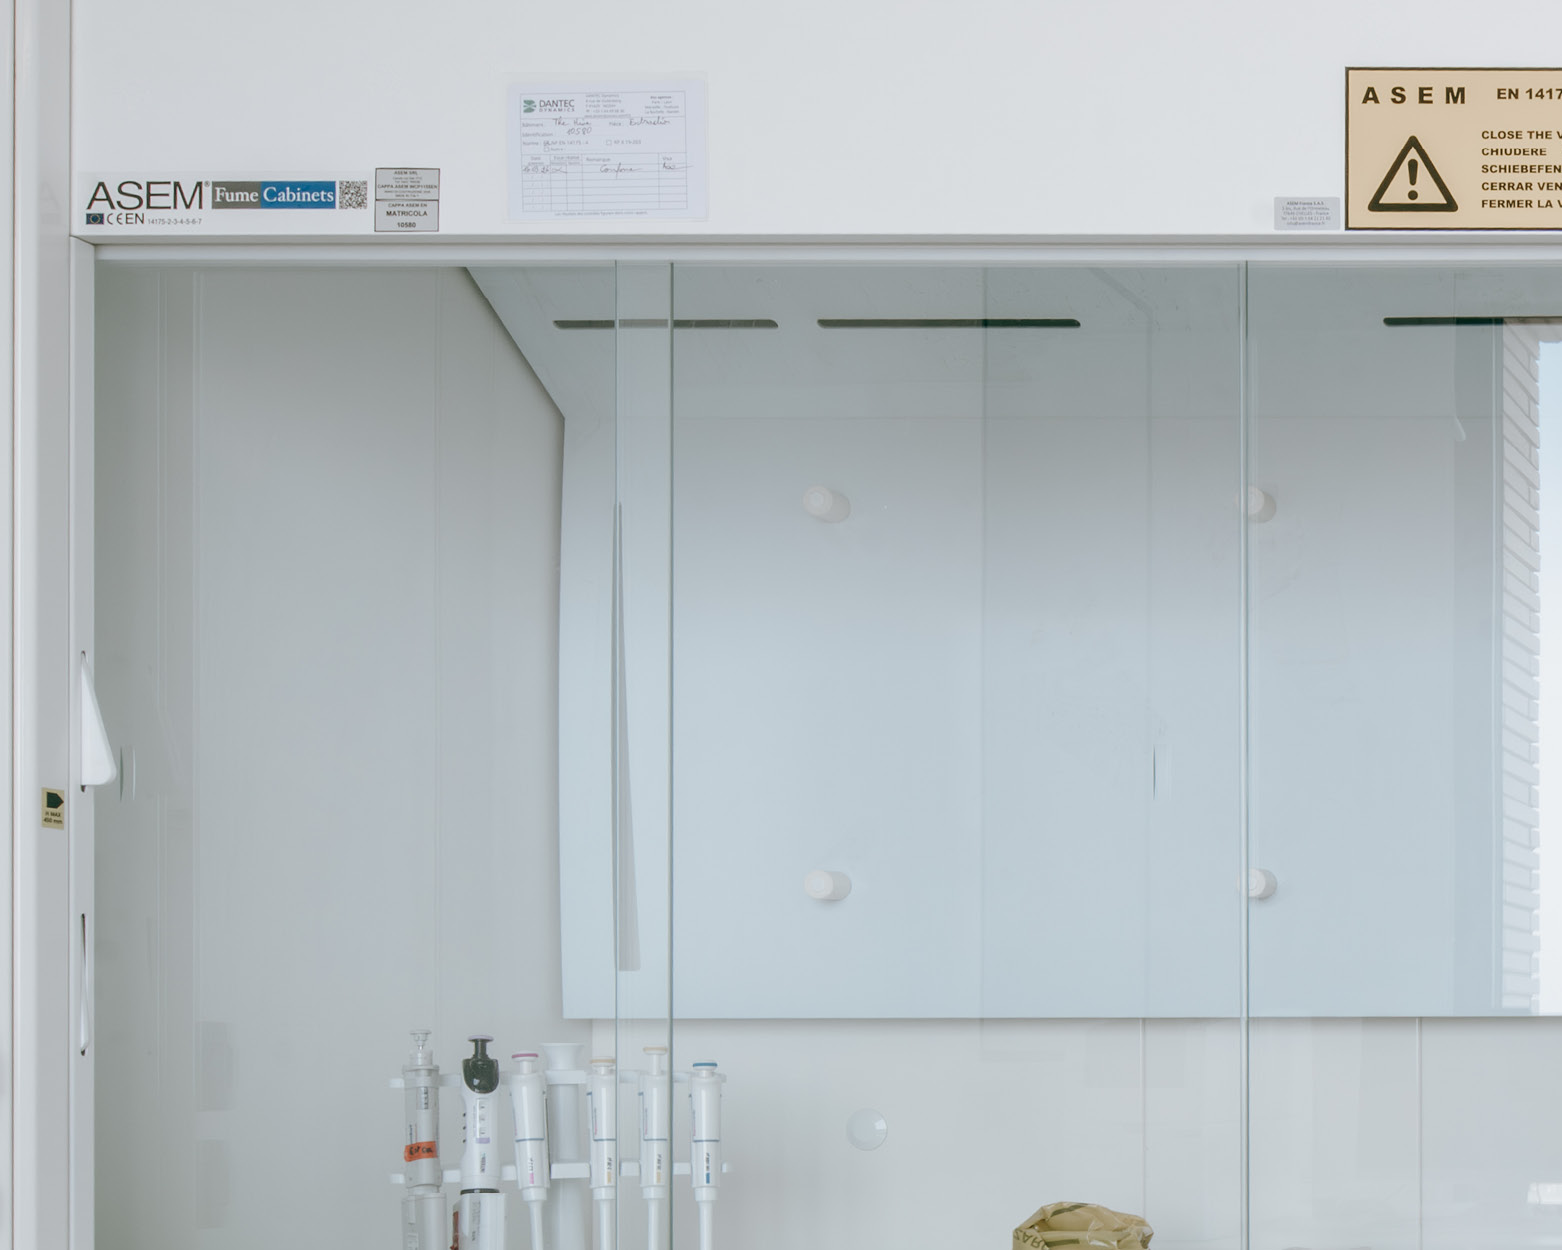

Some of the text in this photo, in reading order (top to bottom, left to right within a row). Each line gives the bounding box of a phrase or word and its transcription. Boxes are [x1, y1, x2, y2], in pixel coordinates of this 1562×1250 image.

[1496, 88, 1519, 100] EN
[539, 99, 575, 108] DANTEC
[1481, 130, 1523, 140] CLOSE
[1527, 130, 1553, 140] THE
[1481, 148, 1547, 156] CHIUDERE
[1481, 182, 1533, 191] CERRAR
[86, 180, 203, 210] ASEM
[214, 186, 334, 202] Fume Cabinets
[1481, 199, 1533, 209] FERMER
[1537, 199, 1553, 209] LA
[125, 213, 145, 225] EN
